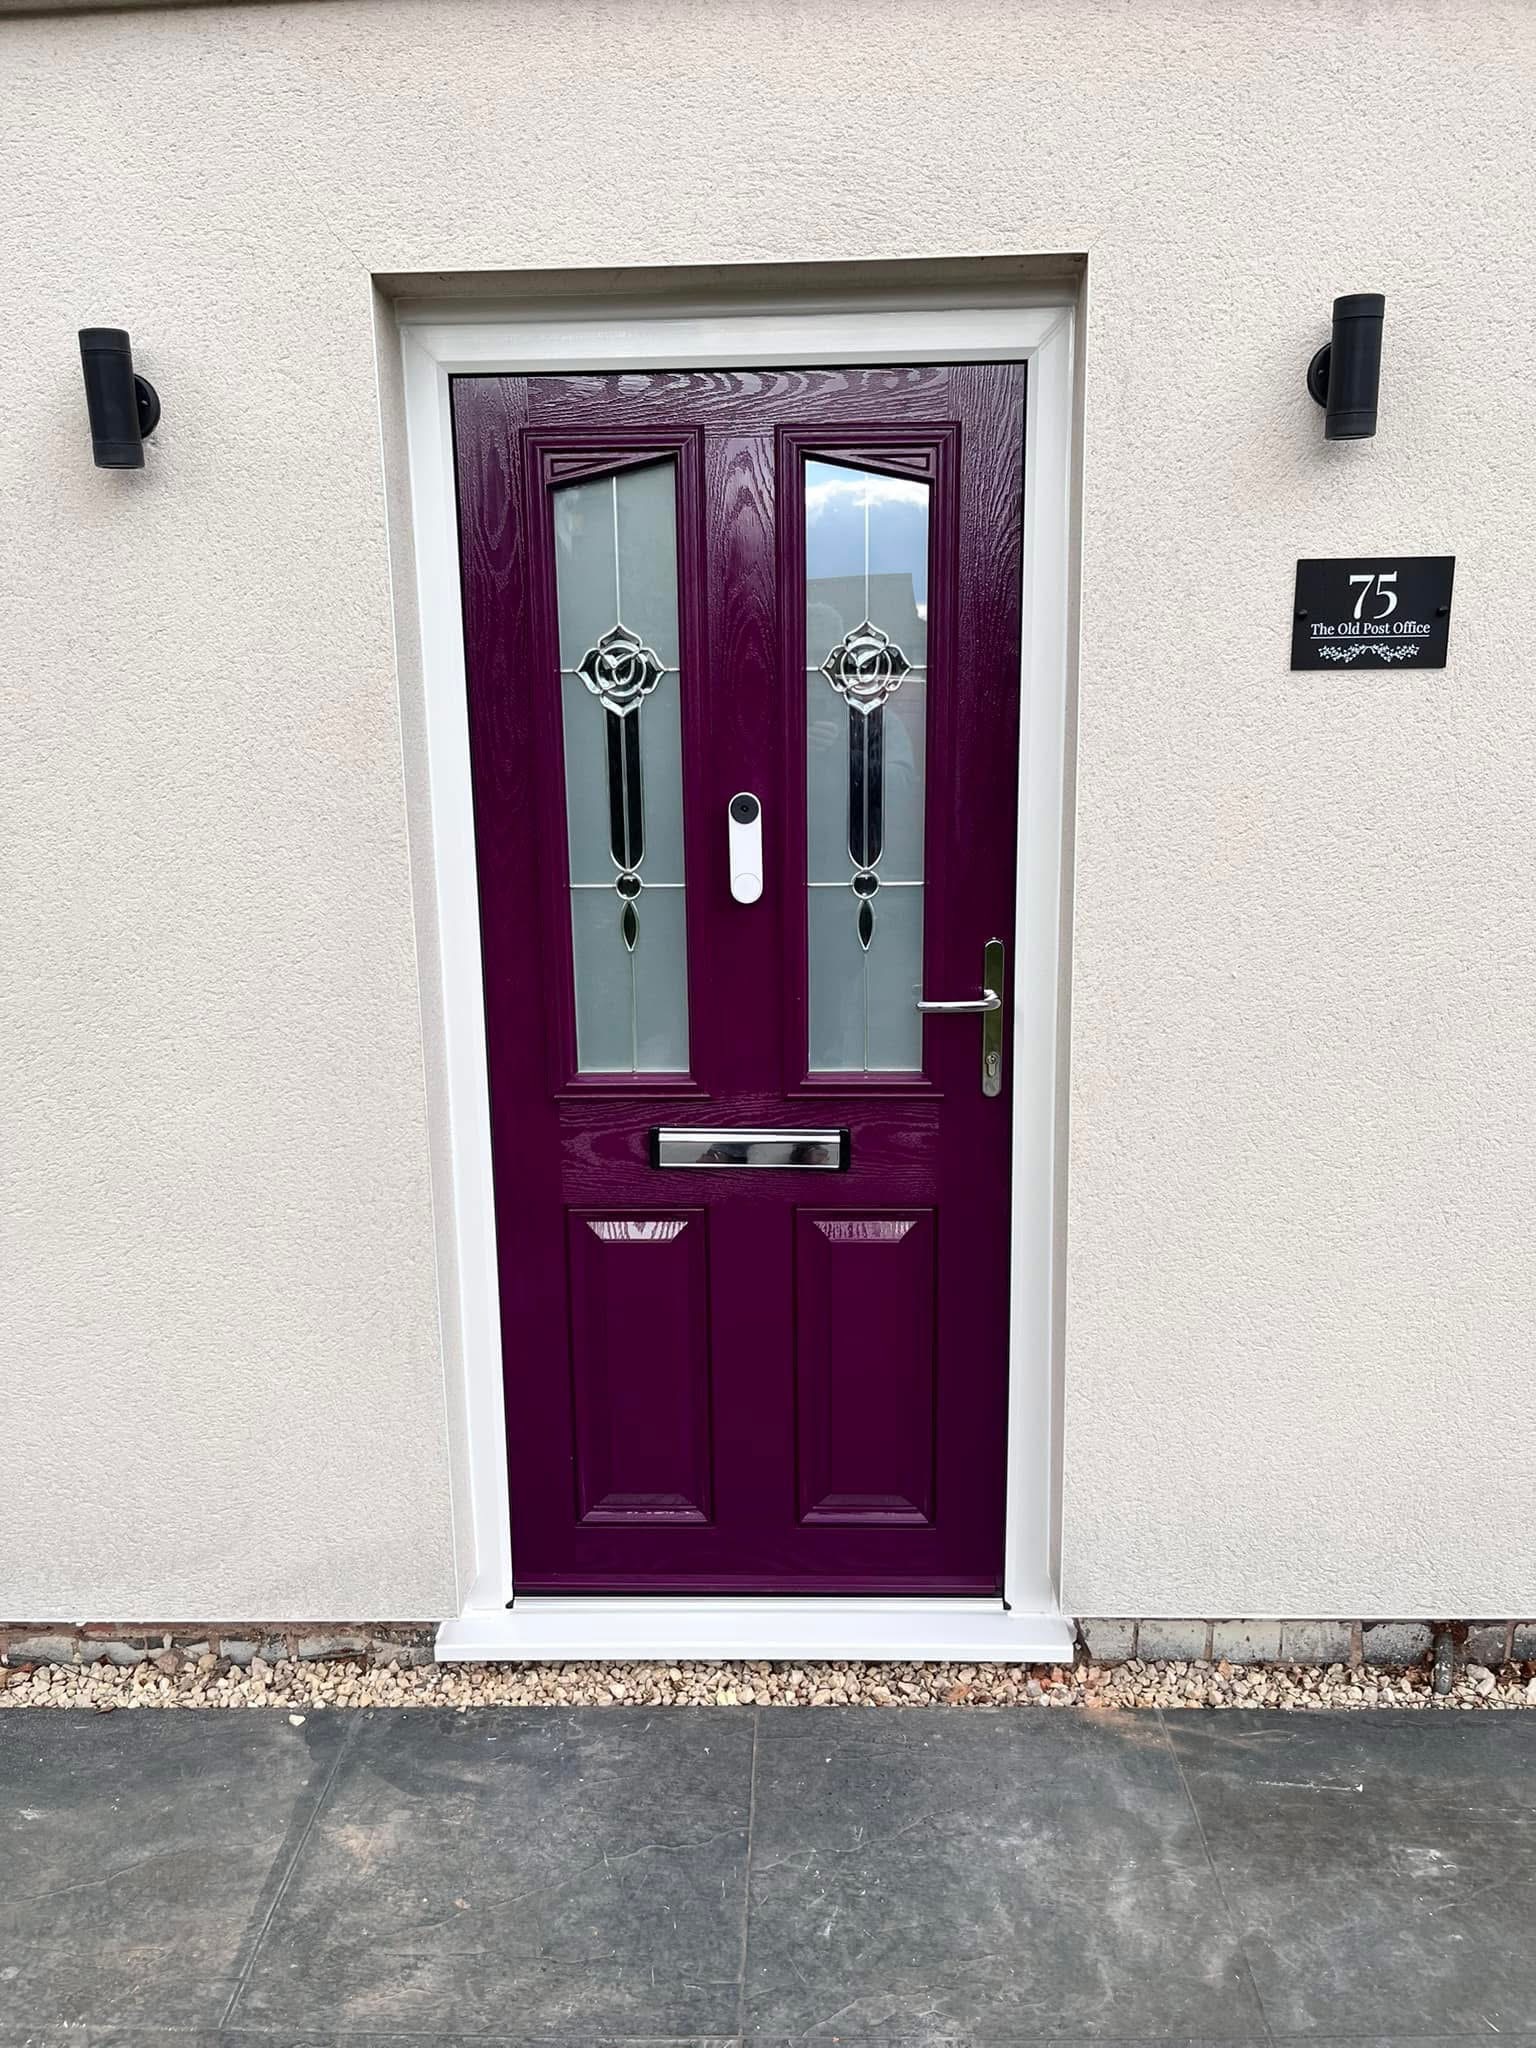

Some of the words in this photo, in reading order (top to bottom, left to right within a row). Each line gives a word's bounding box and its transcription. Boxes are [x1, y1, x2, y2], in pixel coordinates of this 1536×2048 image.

[1349, 571, 1398, 620] 75
[1310, 622, 1335, 636] The
[1337, 622, 1360, 635] Old
[1363, 622, 1391, 635] Post
[1393, 621, 1431, 635] Office
